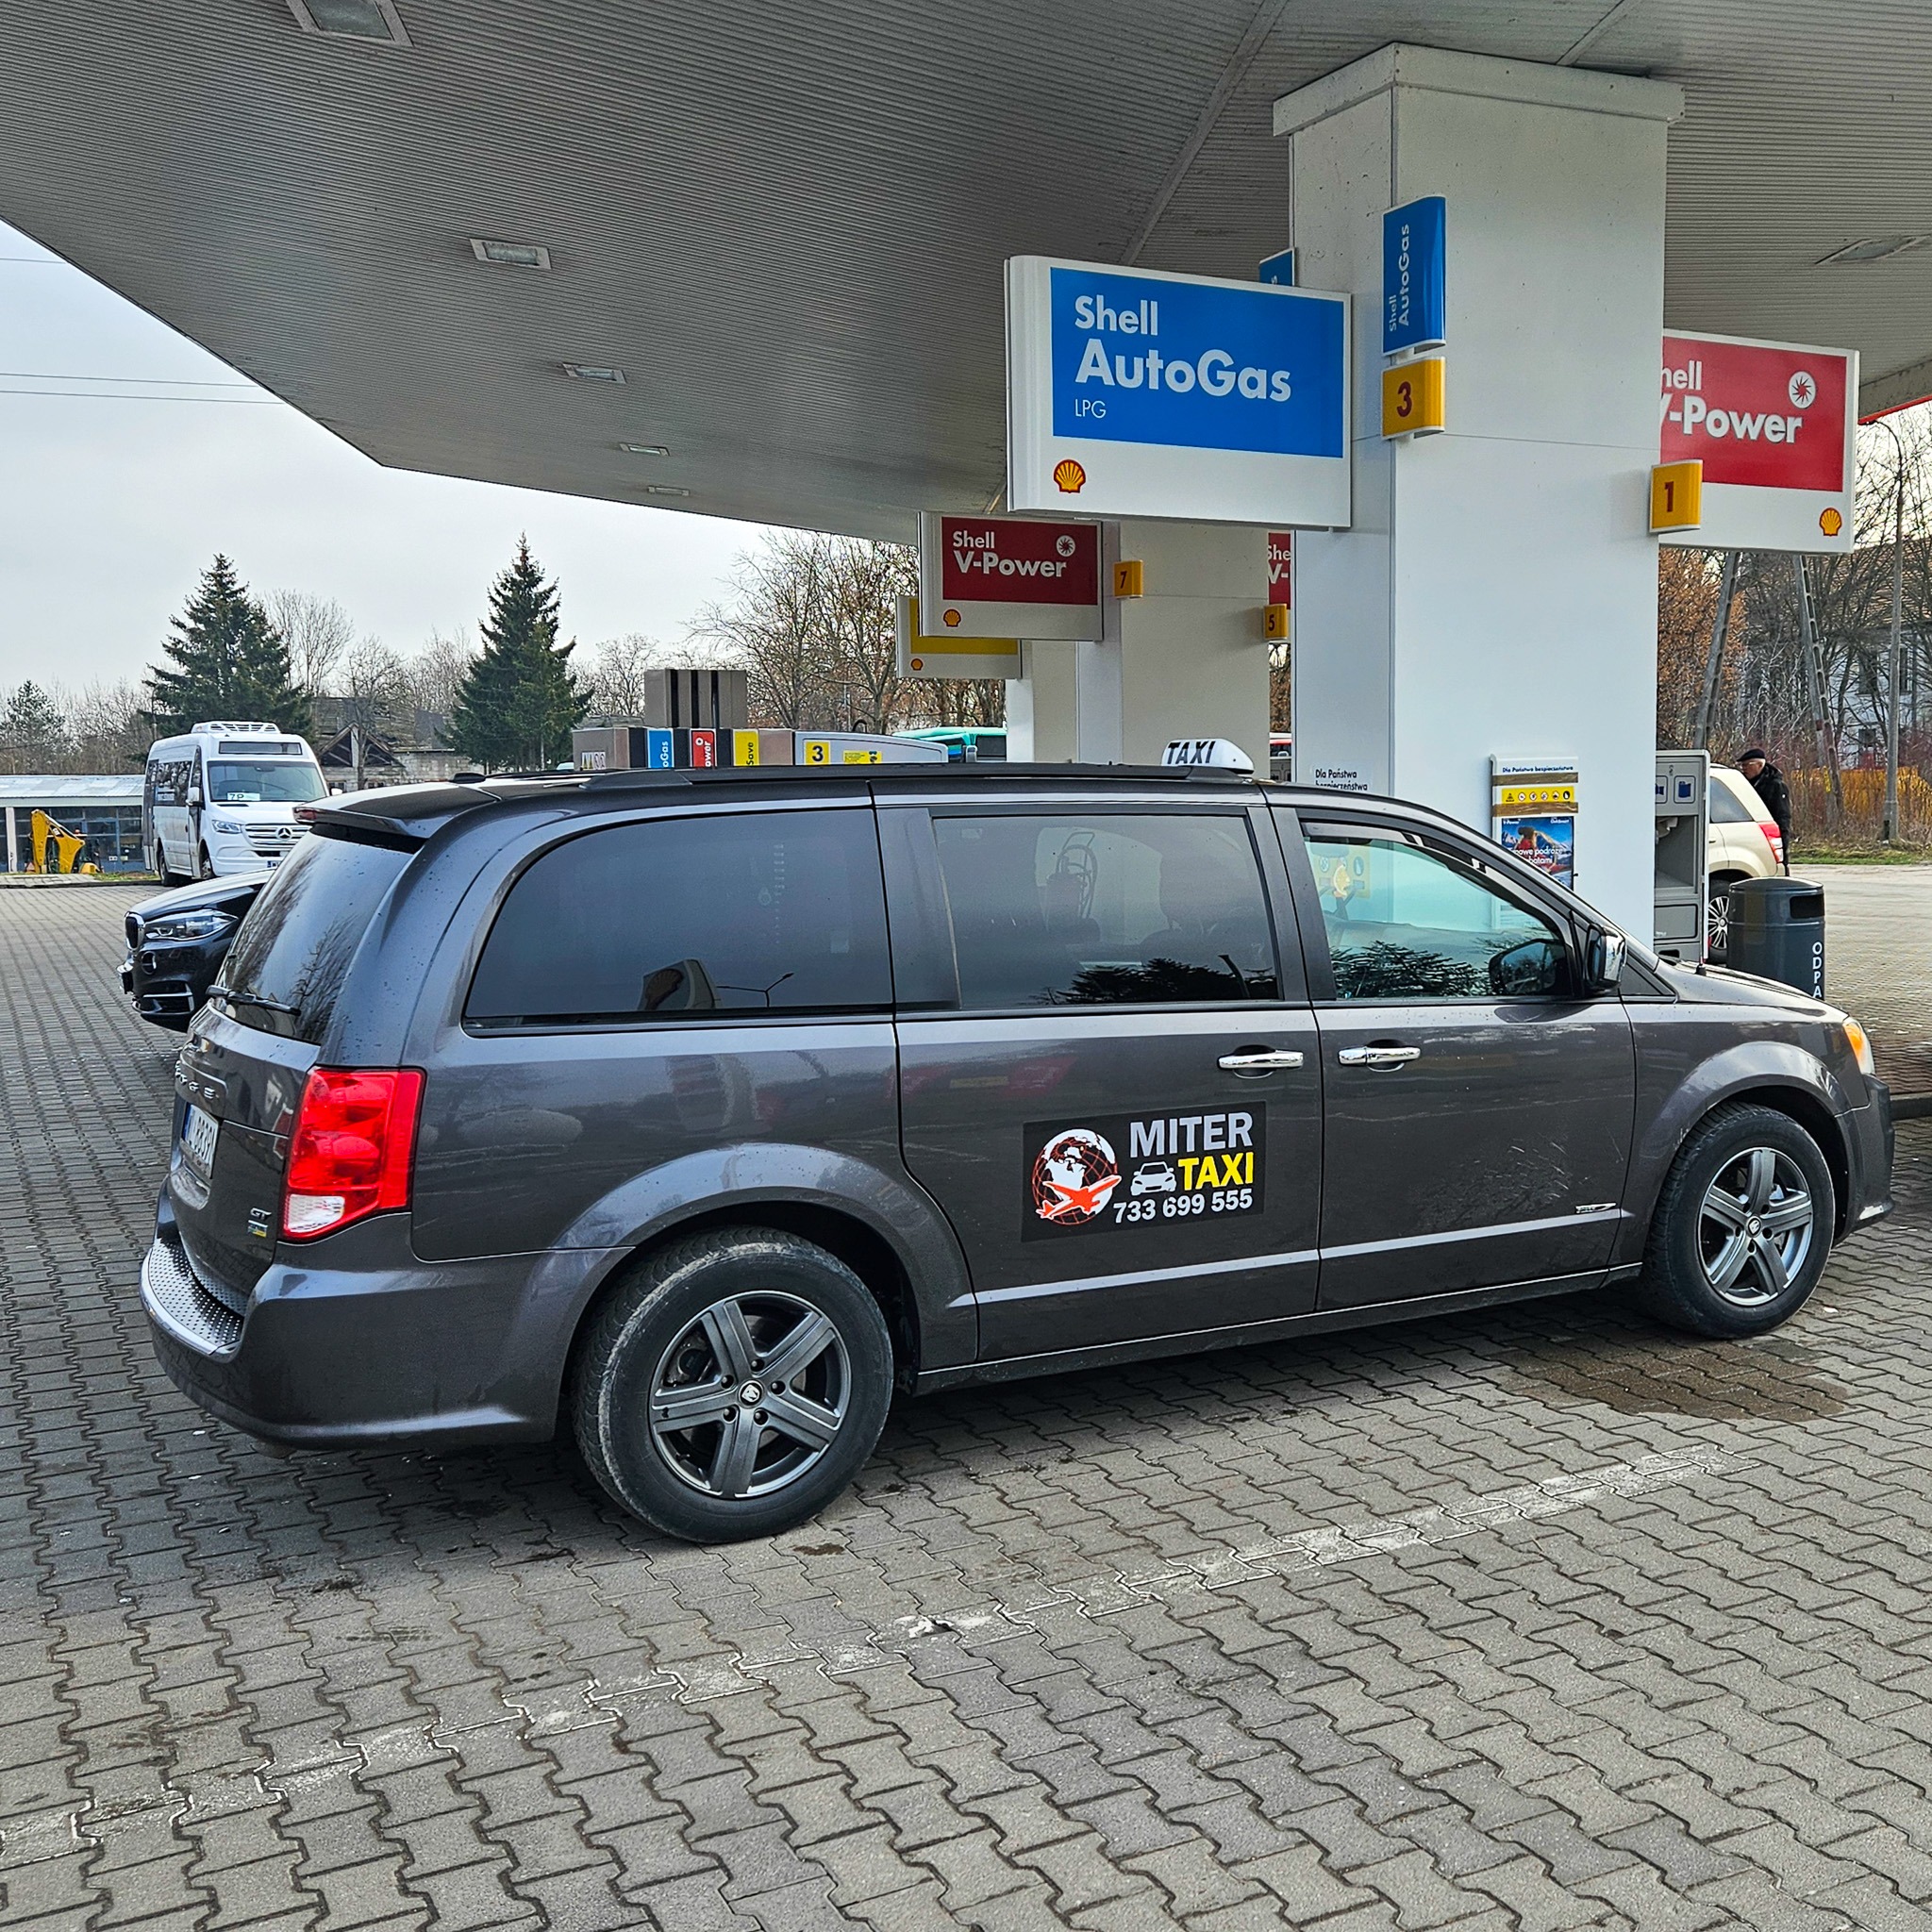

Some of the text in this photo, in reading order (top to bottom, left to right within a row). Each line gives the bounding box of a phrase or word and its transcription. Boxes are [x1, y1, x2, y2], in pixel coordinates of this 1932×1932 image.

[1397, 223, 1410, 326] AutoGas
[1074, 294, 1158, 337] Shell
[1389, 294, 1397, 332] Shell
[1074, 338, 1291, 403] AutoGas
[1074, 399, 1107, 419] LPG
[1396, 381, 1413, 418] 3
[1664, 481, 1674, 512] 1
[952, 530, 995, 550] Shell
[953, 549, 1067, 578] V-Power
[1119, 570, 1127, 590] 7
[1268, 613, 1275, 631] 5
[659, 741, 669, 768] oGas
[811, 744, 824, 762] 3
[1167, 741, 1216, 765] TAXI
[1315, 768, 1357, 778] Dla Państwa
[1811, 941, 1823, 998] ODPA
[1129, 1111, 1254, 1158] MITER
[1177, 1151, 1255, 1191] TAXI
[250, 1207, 273, 1220] GT
[1112, 1188, 1254, 1224] 733 699 555
